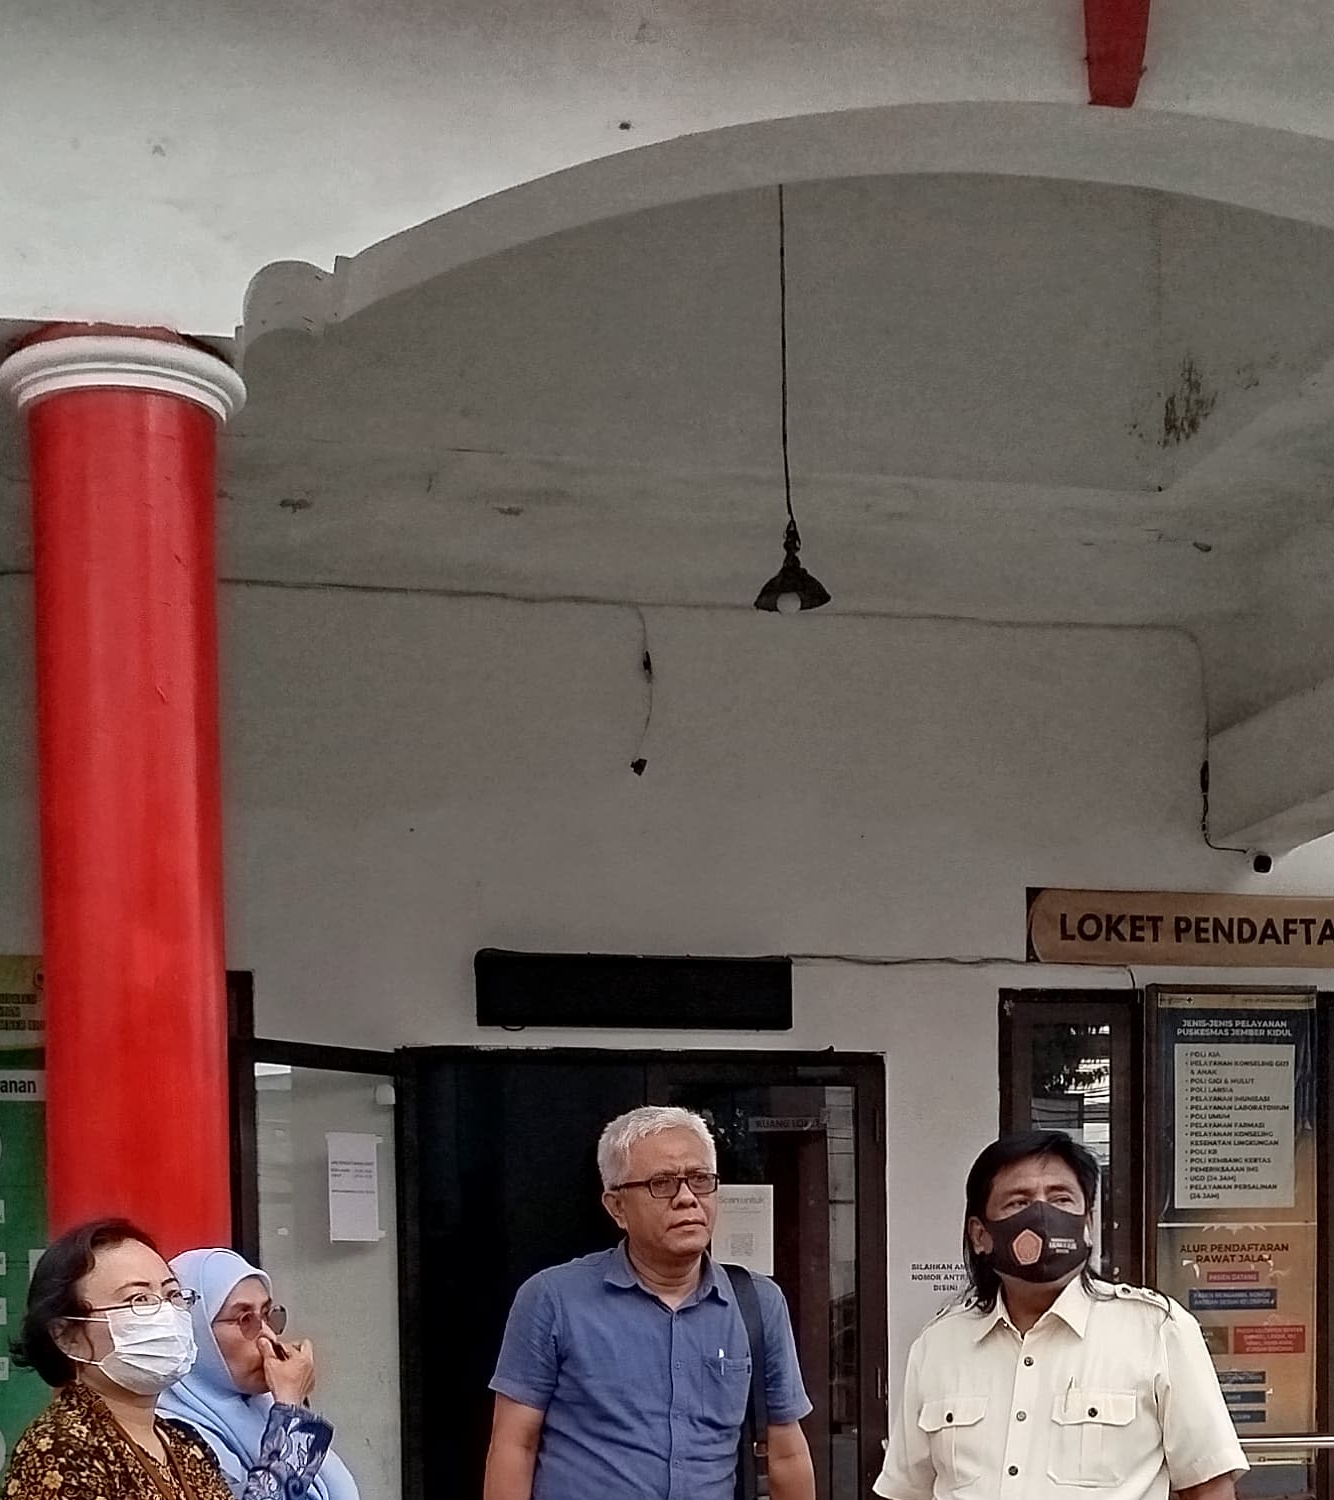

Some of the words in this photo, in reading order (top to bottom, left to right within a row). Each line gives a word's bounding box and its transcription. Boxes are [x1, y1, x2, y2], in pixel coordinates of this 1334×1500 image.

[1059, 912, 1164, 943] LOKET
[1182, 1019, 1234, 1028] JENIS-JENIS
[1235, 1020, 1288, 1028] PELAYANAN
[1177, 1028, 1230, 1036] PUSKESMAS
[1230, 1028, 1266, 1037] JEMBER
[1267, 1029, 1293, 1037] KIDUL
[1180, 1244, 1207, 1253] ALUR
[1210, 1243, 1289, 1252] PENDAFTARAN
[1196, 1254, 1236, 1263] RAWAT
